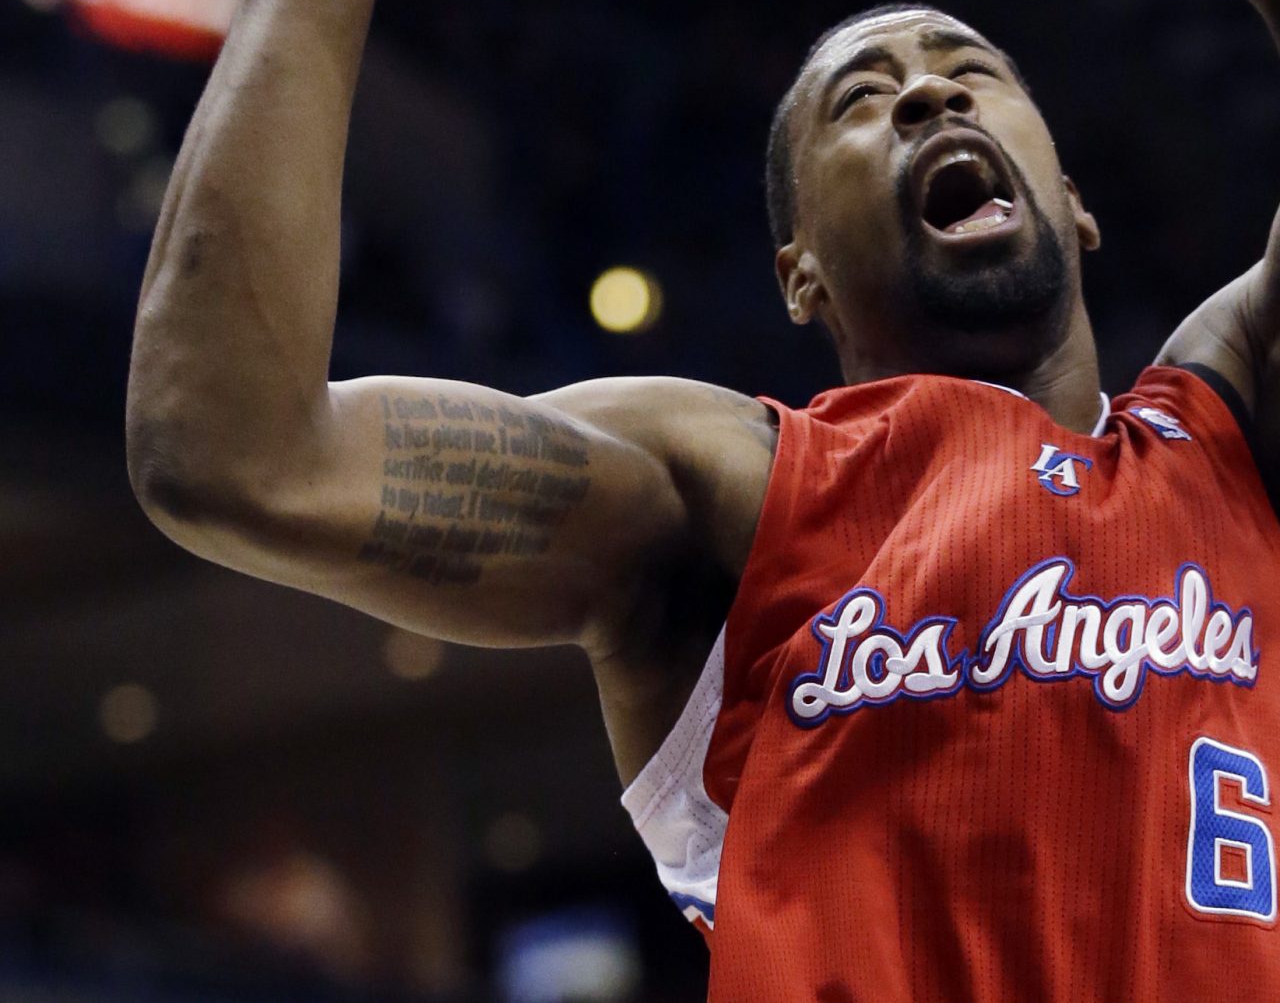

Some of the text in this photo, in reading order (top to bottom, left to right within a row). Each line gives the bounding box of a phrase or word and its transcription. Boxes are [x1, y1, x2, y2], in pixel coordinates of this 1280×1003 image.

[789, 558, 1260, 724] Los Angeles
[1186, 737, 1278, 923] 6
